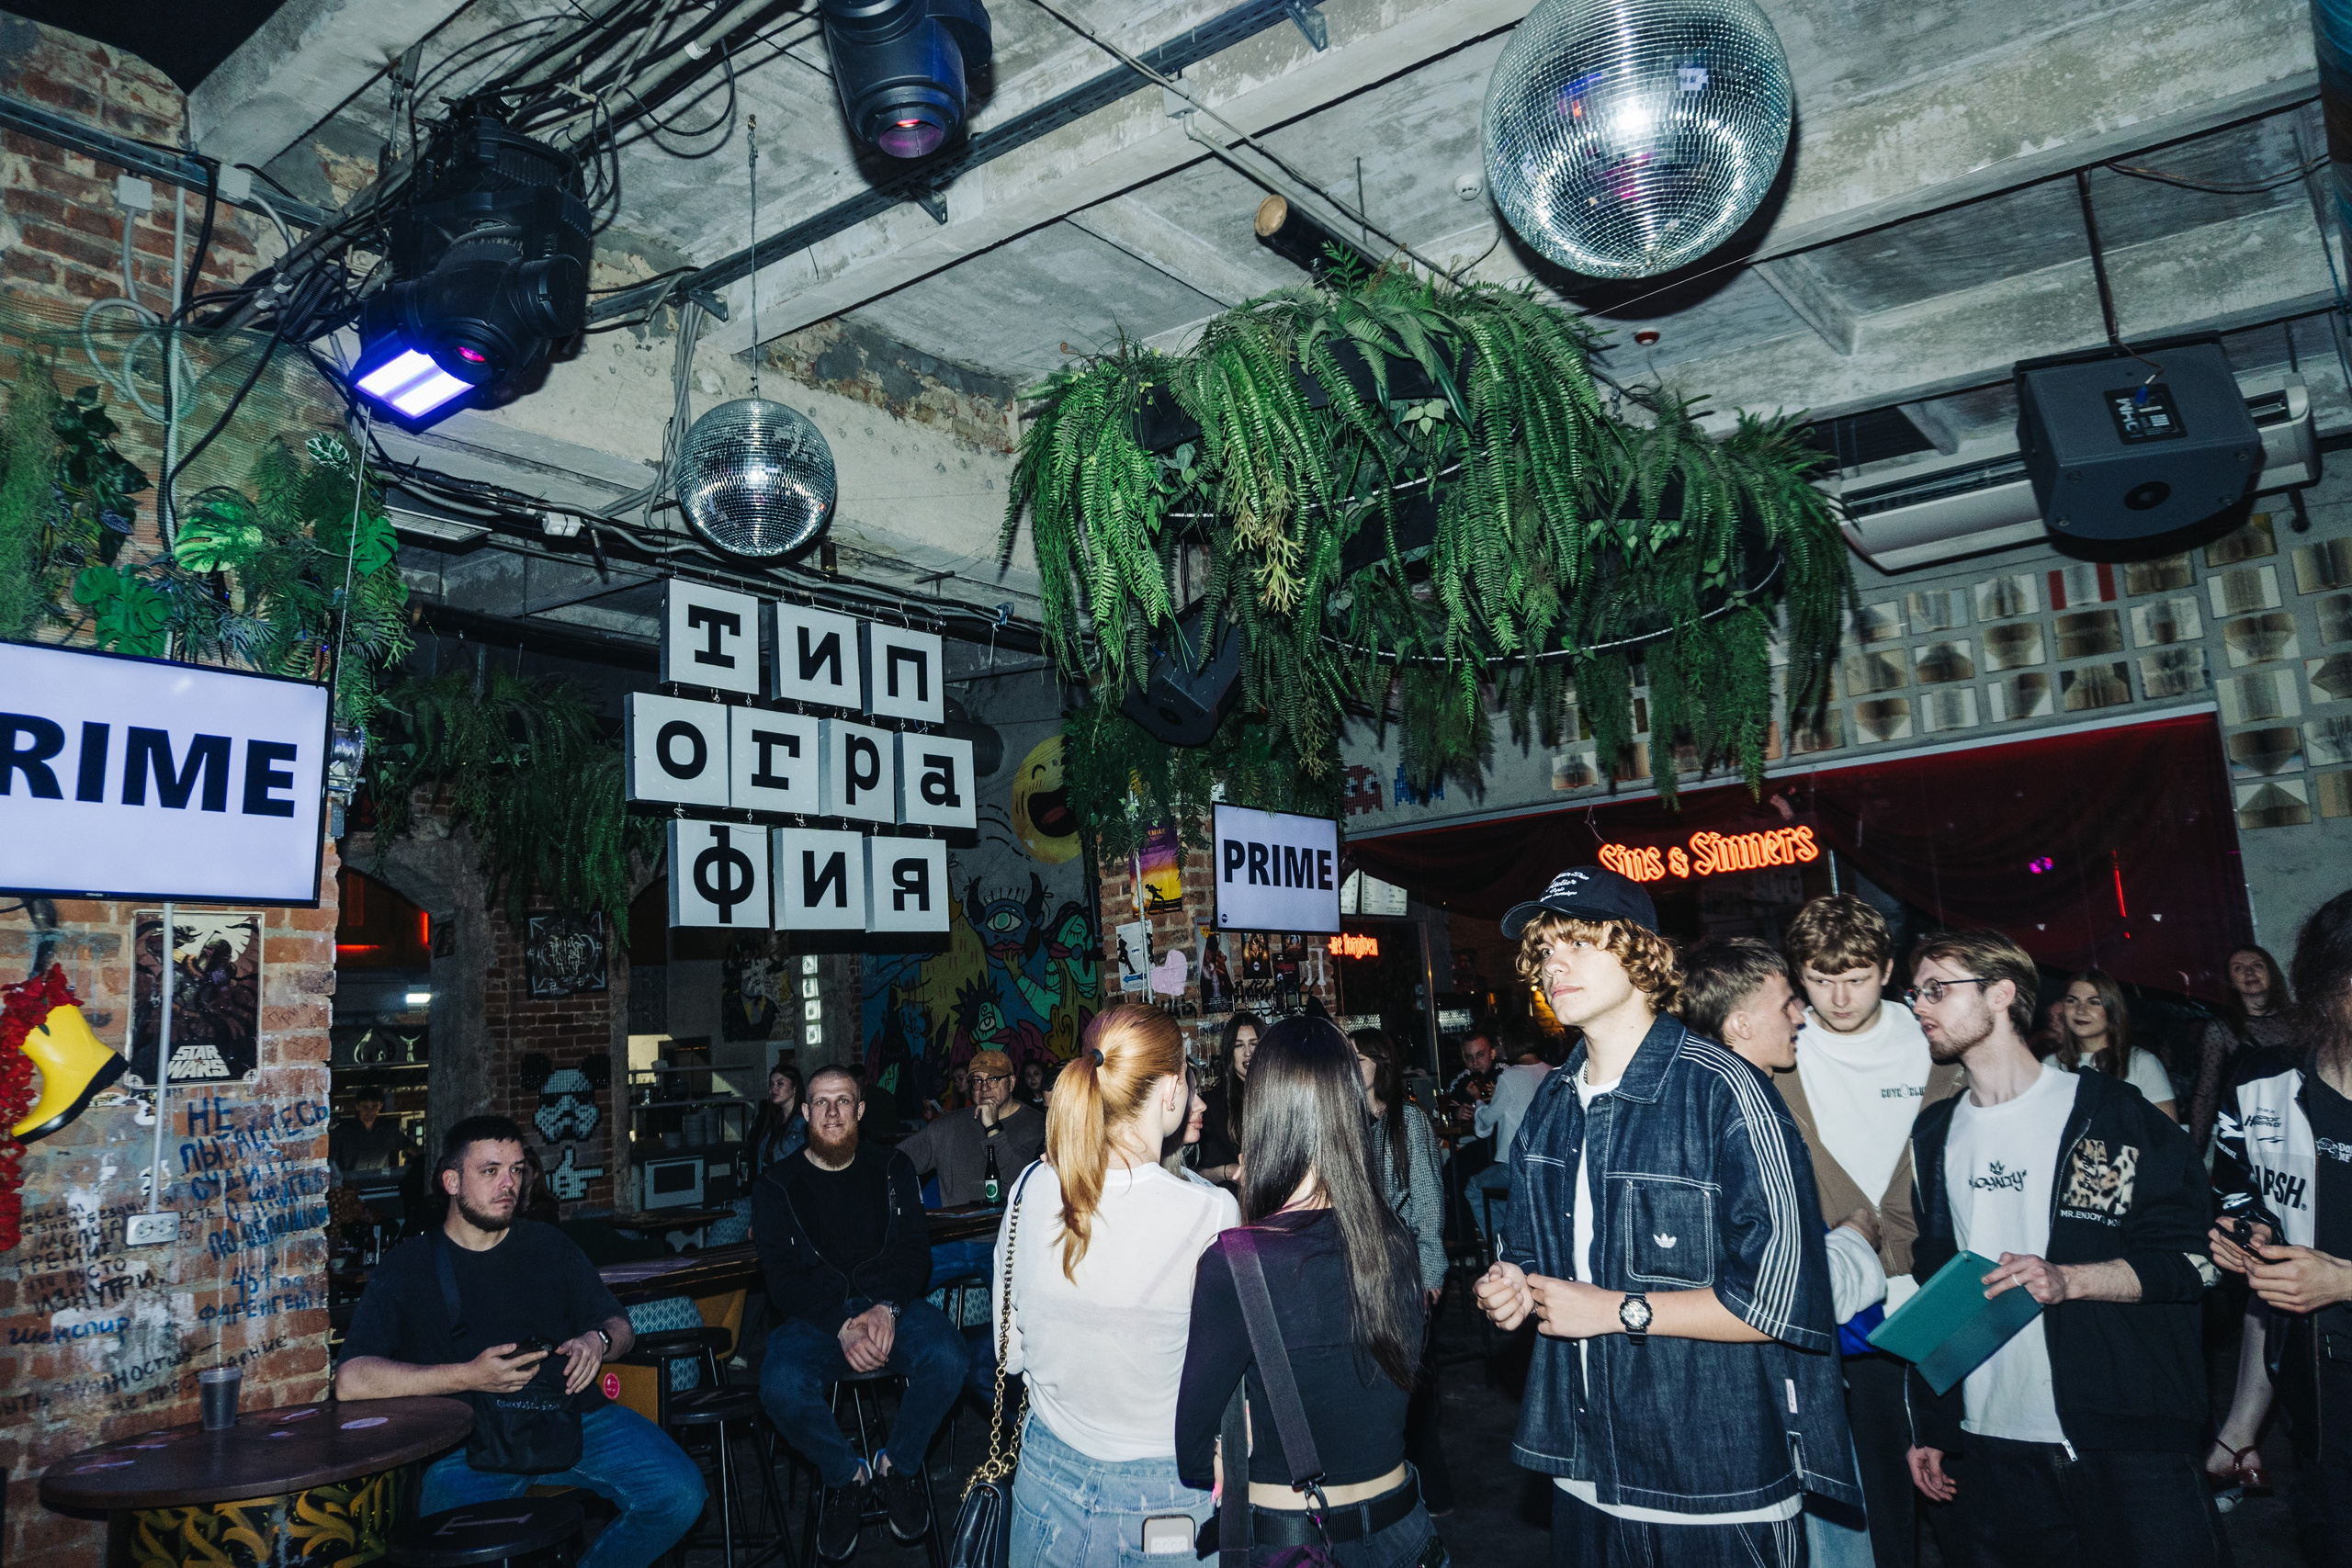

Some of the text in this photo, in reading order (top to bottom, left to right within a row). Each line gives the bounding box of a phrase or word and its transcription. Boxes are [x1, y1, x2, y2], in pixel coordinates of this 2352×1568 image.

[1223, 839, 1333, 891] PRIME
[1599, 825, 1819, 882] Sins & Sinners
[171, 1044, 222, 1061] STAR
[167, 1059, 232, 1079] WARS
[1908, 1086, 1927, 1097] CLU
[187, 1096, 235, 1137] НЕ
